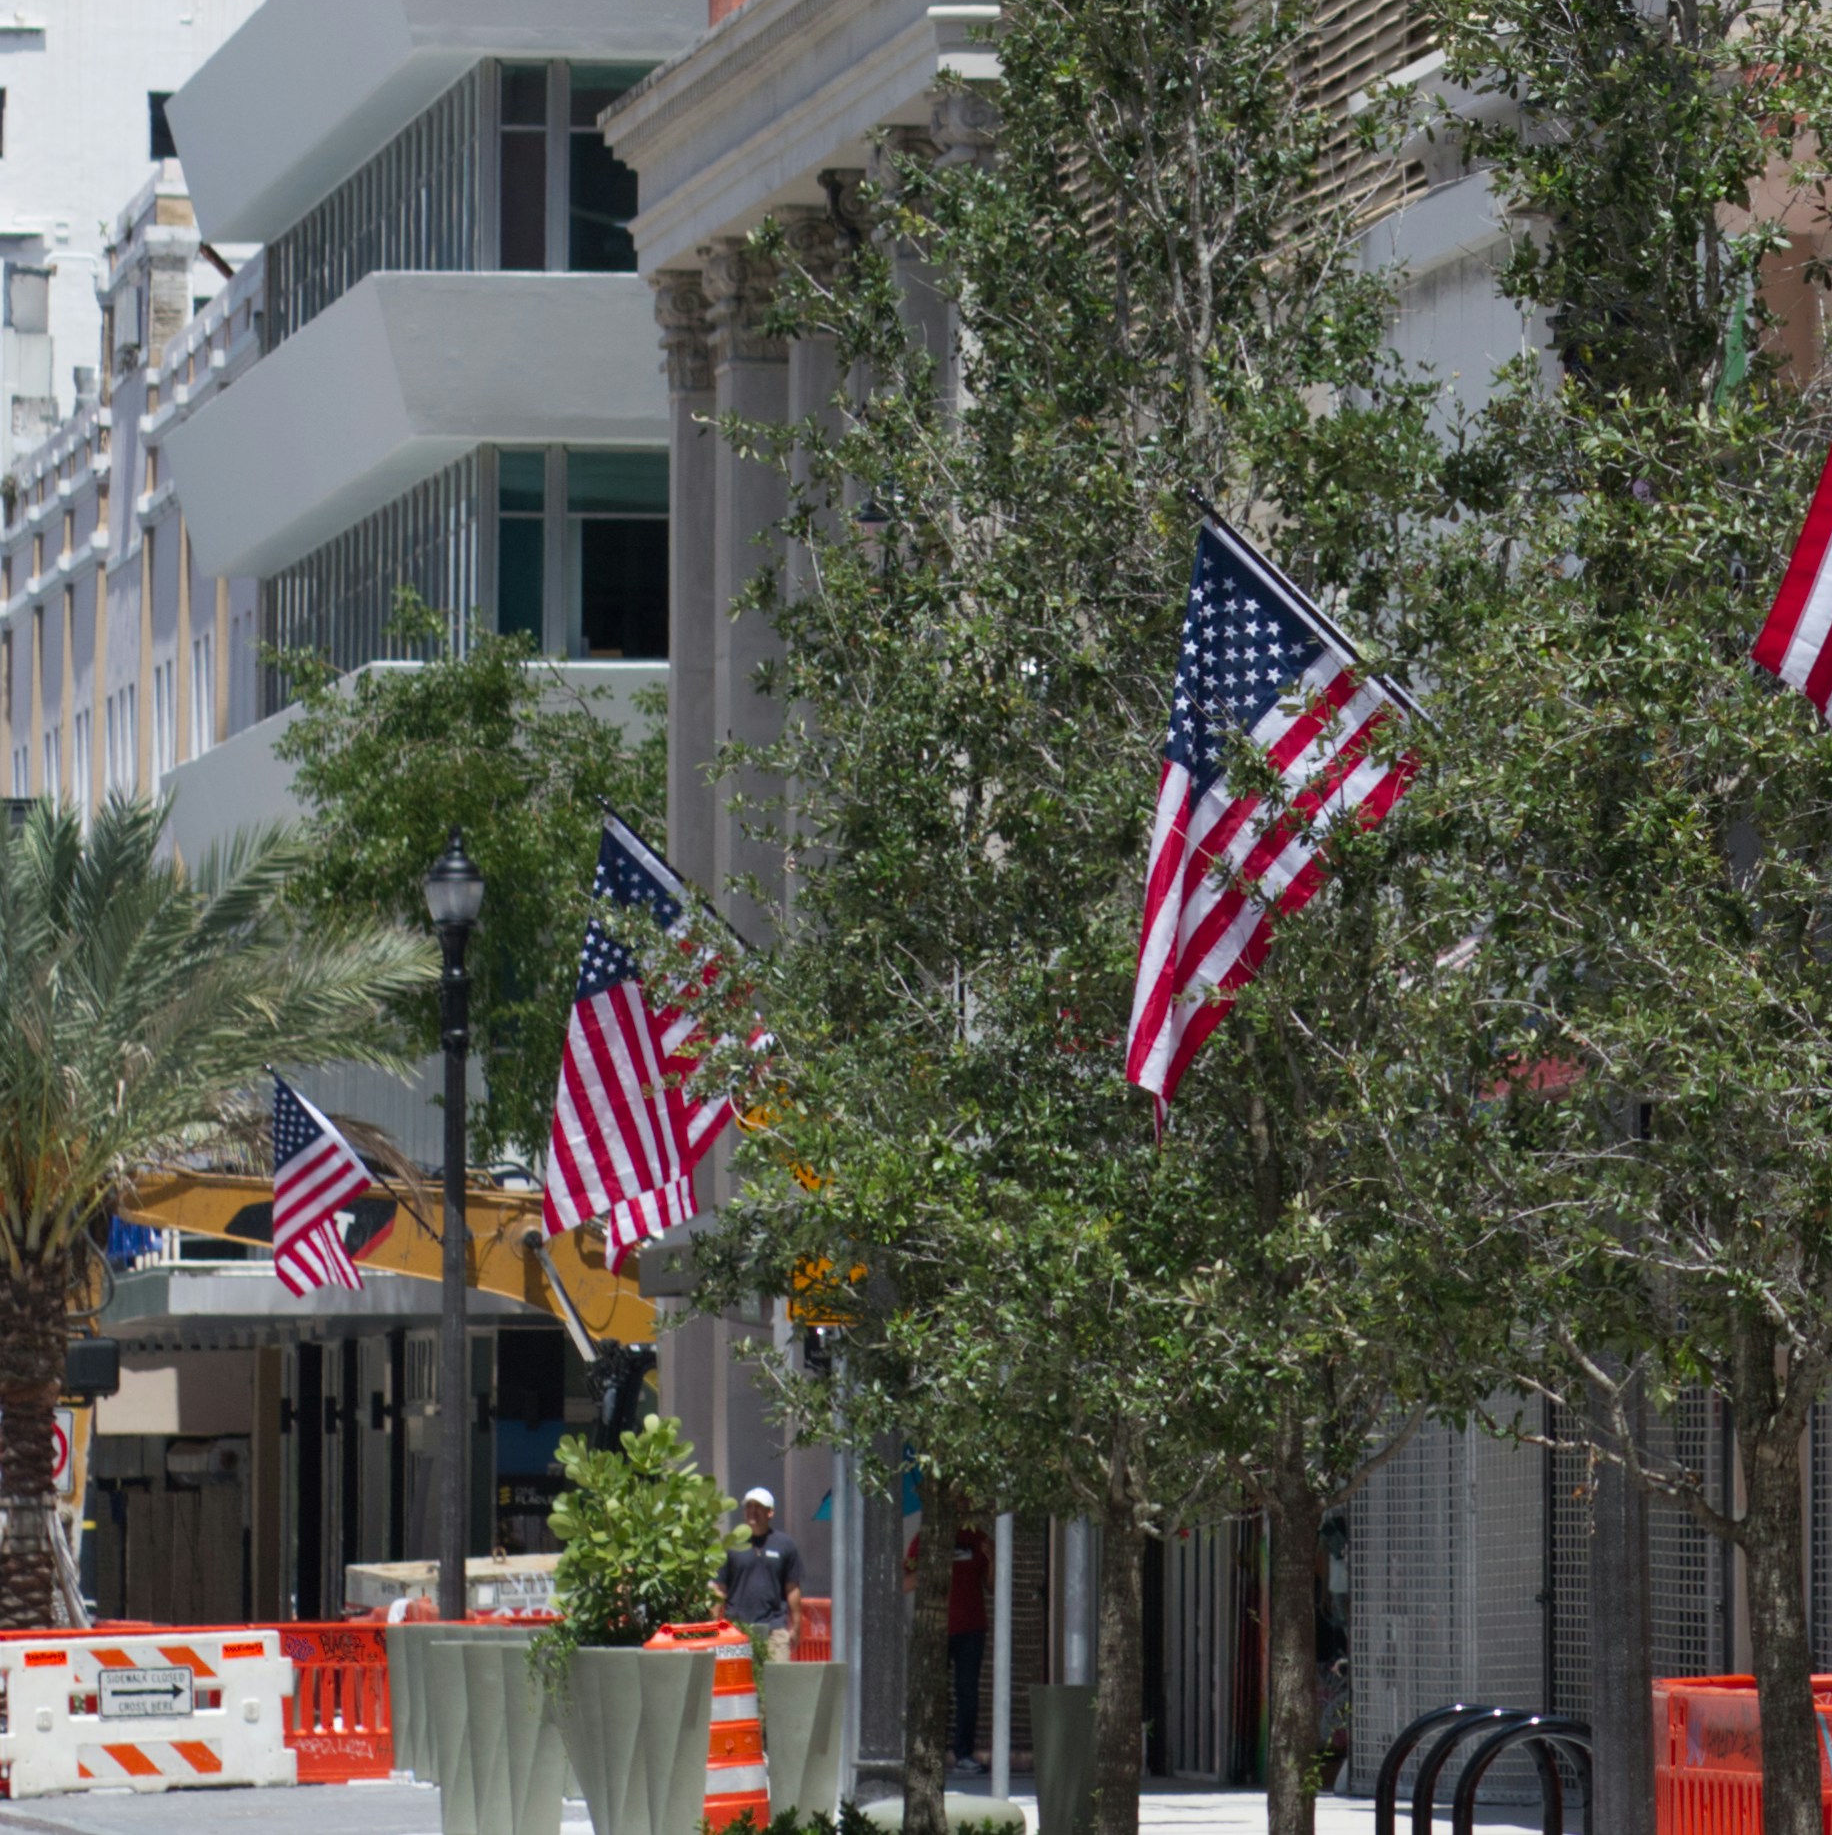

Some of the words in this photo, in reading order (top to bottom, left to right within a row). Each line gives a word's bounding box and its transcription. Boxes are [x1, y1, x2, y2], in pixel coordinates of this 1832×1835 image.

[106, 1673, 148, 1684] SIDEWALK
[151, 1672, 186, 1683] CLOSED
[118, 1702, 148, 1712] CROSS
[151, 1701, 174, 1712] HERE
